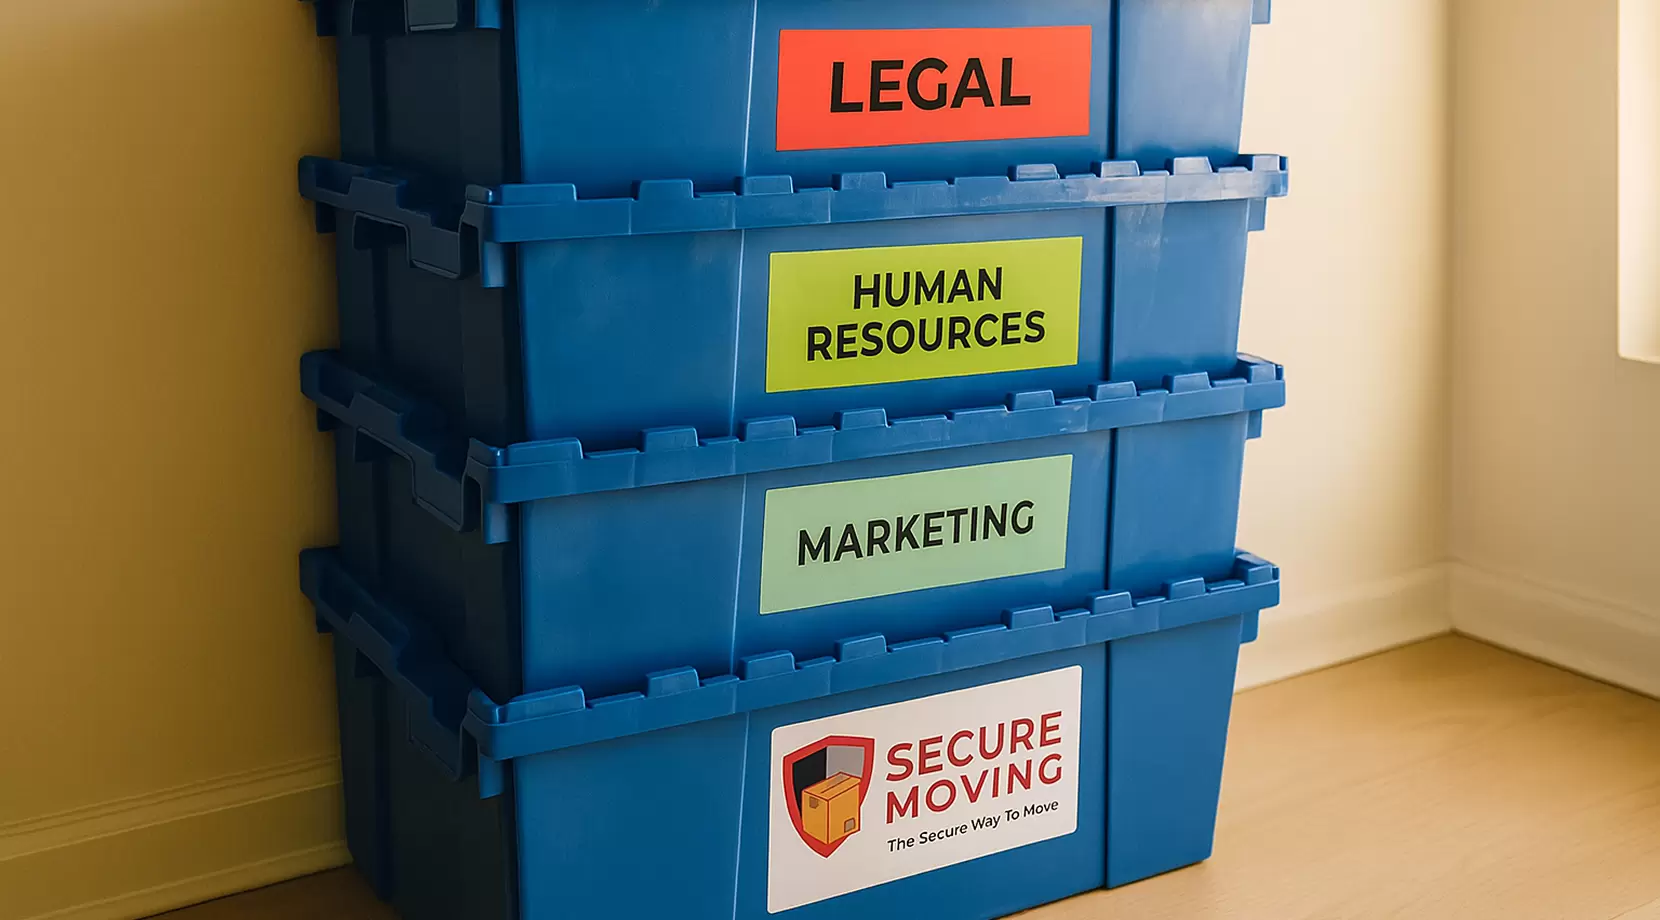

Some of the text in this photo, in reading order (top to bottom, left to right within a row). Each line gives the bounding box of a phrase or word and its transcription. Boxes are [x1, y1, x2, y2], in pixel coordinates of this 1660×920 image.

[829, 57, 1031, 113] LEGAL
[853, 266, 1003, 310] HUMAN
[807, 311, 1046, 362] RESOURCES
[797, 500, 1035, 567] MARKETING
[885, 711, 1062, 782] SECURE
[886, 753, 1062, 824] MOVING
[887, 800, 1059, 852] The Secure Way To Move
